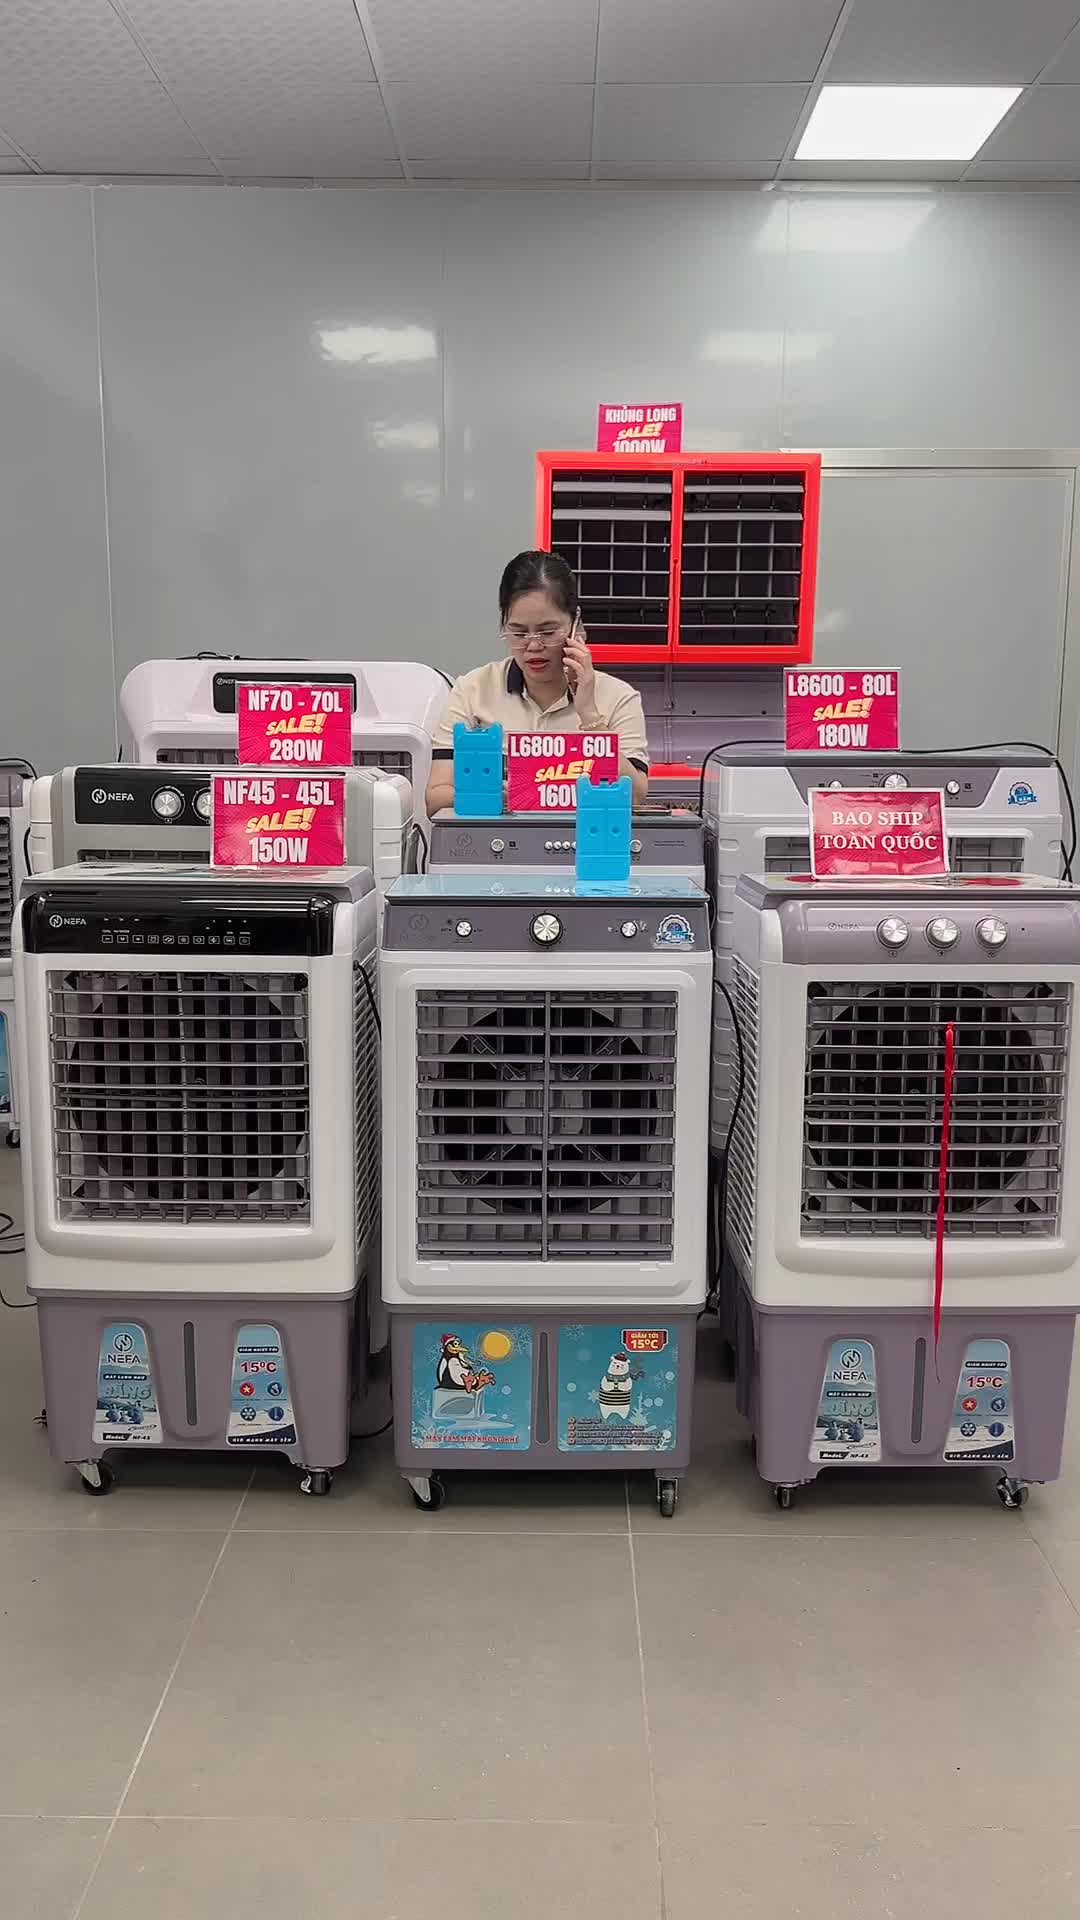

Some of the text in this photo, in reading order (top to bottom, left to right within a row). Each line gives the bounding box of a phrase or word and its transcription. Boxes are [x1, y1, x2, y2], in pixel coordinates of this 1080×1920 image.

[605, 405, 677, 423] KHỦNG LONG
[617, 422, 664, 440] SALE!
[788, 674, 845, 697] L8600
[862, 674, 896, 696] 80L
[248, 689, 293, 711] NF70
[310, 690, 343, 712] 70L
[812, 697, 874, 721] SALE!
[265, 713, 327, 736] SALE!
[817, 723, 869, 747] 180W
[270, 739, 323, 761] 280W
[510, 735, 566, 757] L6800
[582, 735, 615, 757] 60L
[534, 759, 595, 782] SALE!
[107, 792, 135, 801] NEFA
[223, 780, 275, 805] NF45
[295, 780, 335, 805] 45L
[245, 807, 316, 834] SALE!
[831, 811, 923, 826] BAO SHIP
[249, 837, 309, 863] 150W
[449, 849, 480, 857] NEFA
[819, 831, 938, 853] TOÀN QUỐC
[64, 917, 87, 925] NEFA
[107, 1354, 141, 1364] NEFA
[833, 1371, 867, 1380] NEFA
